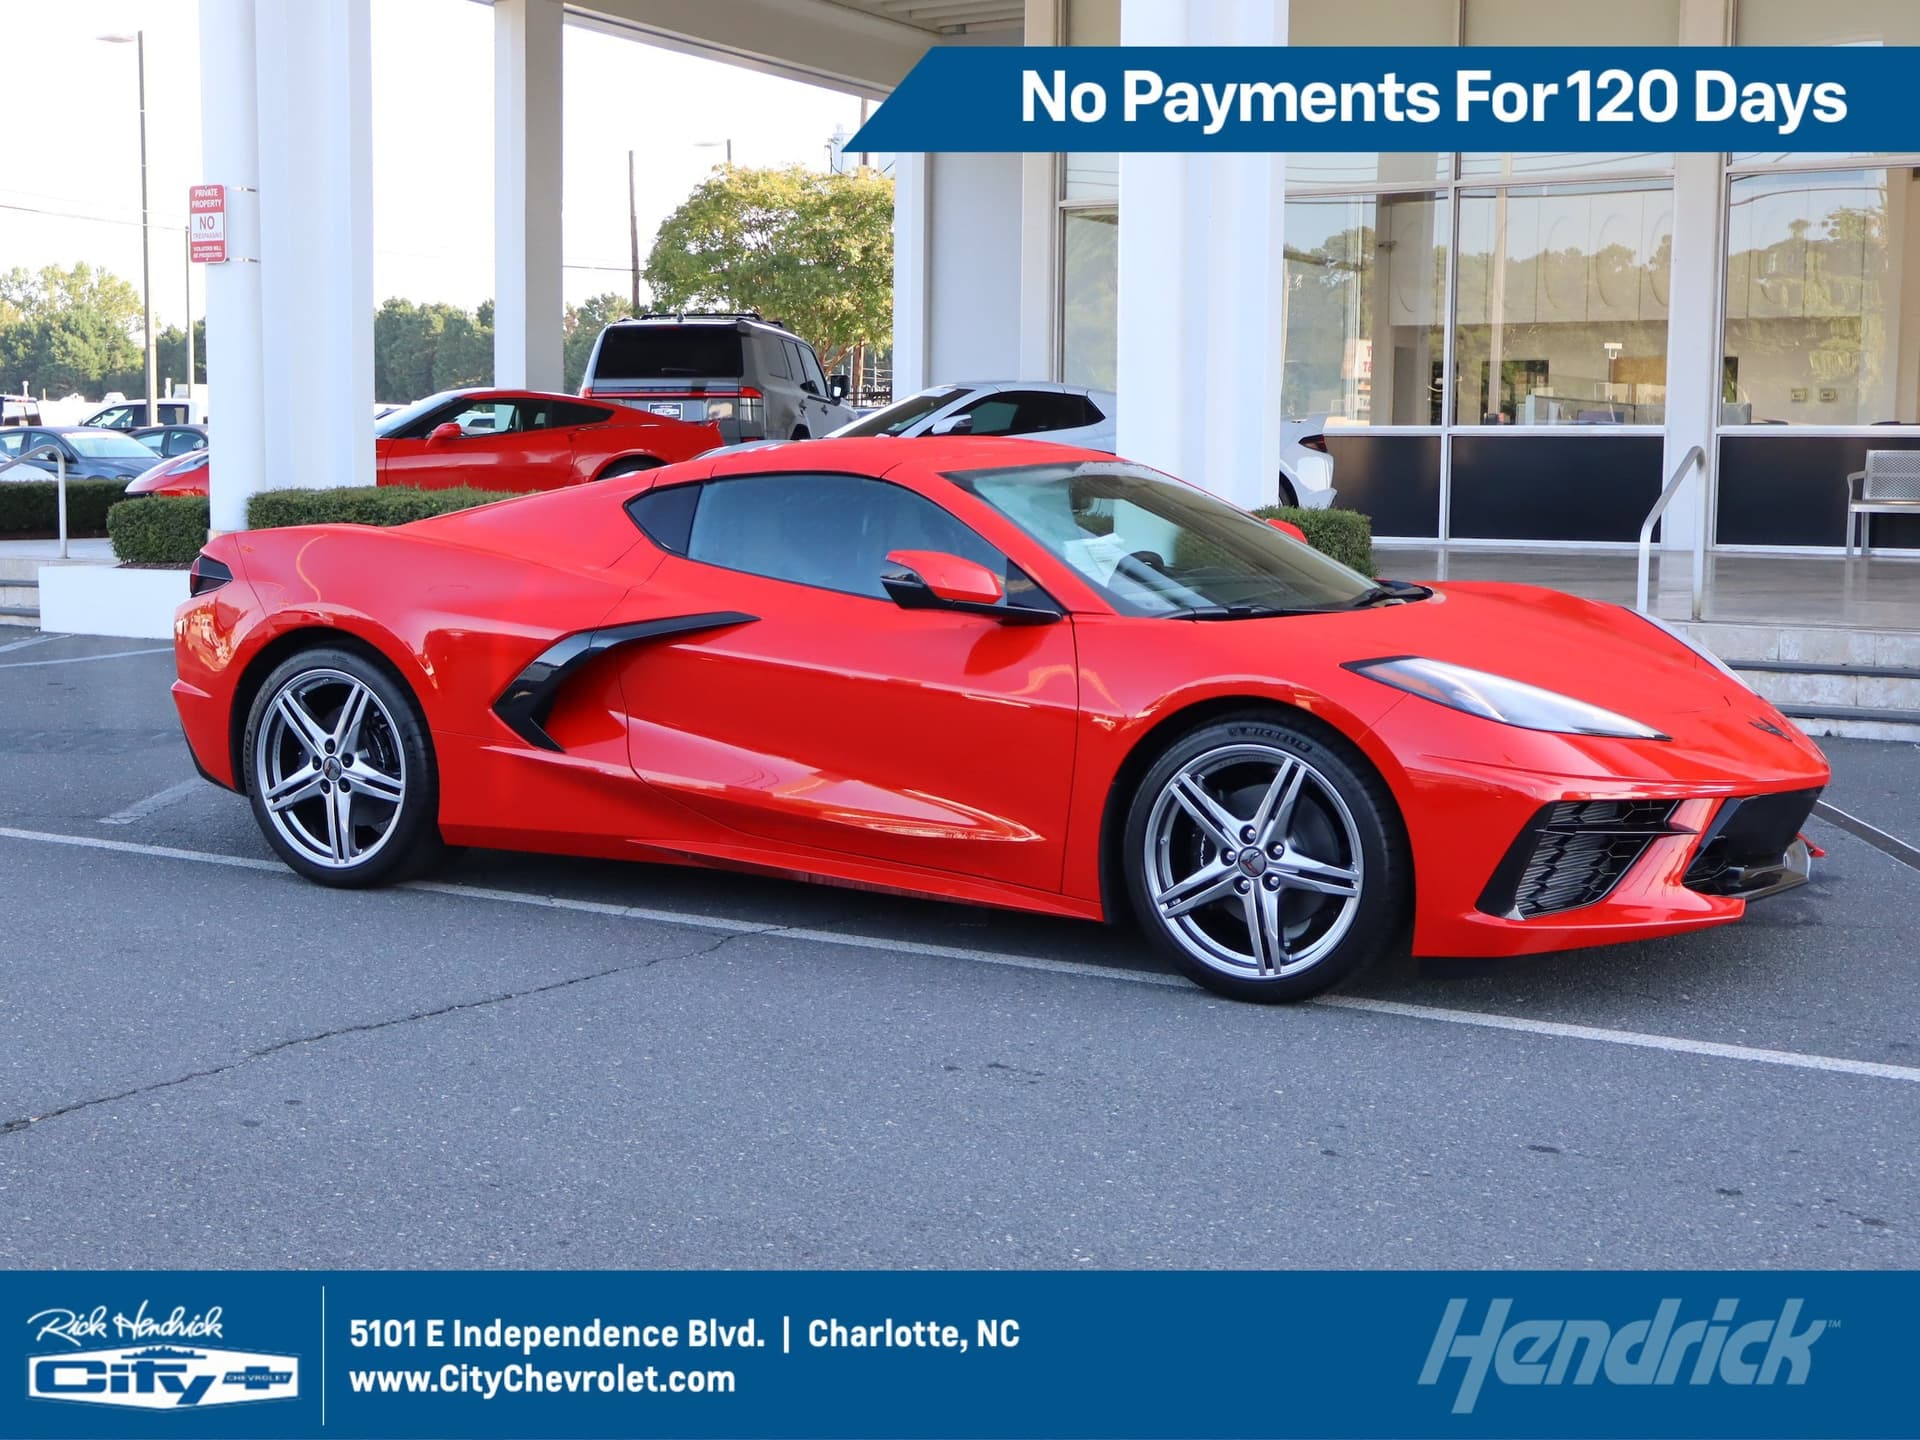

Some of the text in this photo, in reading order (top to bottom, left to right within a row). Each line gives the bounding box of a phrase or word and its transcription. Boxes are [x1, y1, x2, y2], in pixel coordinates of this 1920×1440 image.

[194, 188, 218, 197] PRIVATE
[191, 199, 222, 208] PROPERTY
[199, 215, 215, 230] NO
[1245, 727, 1309, 751] MICHELIN
